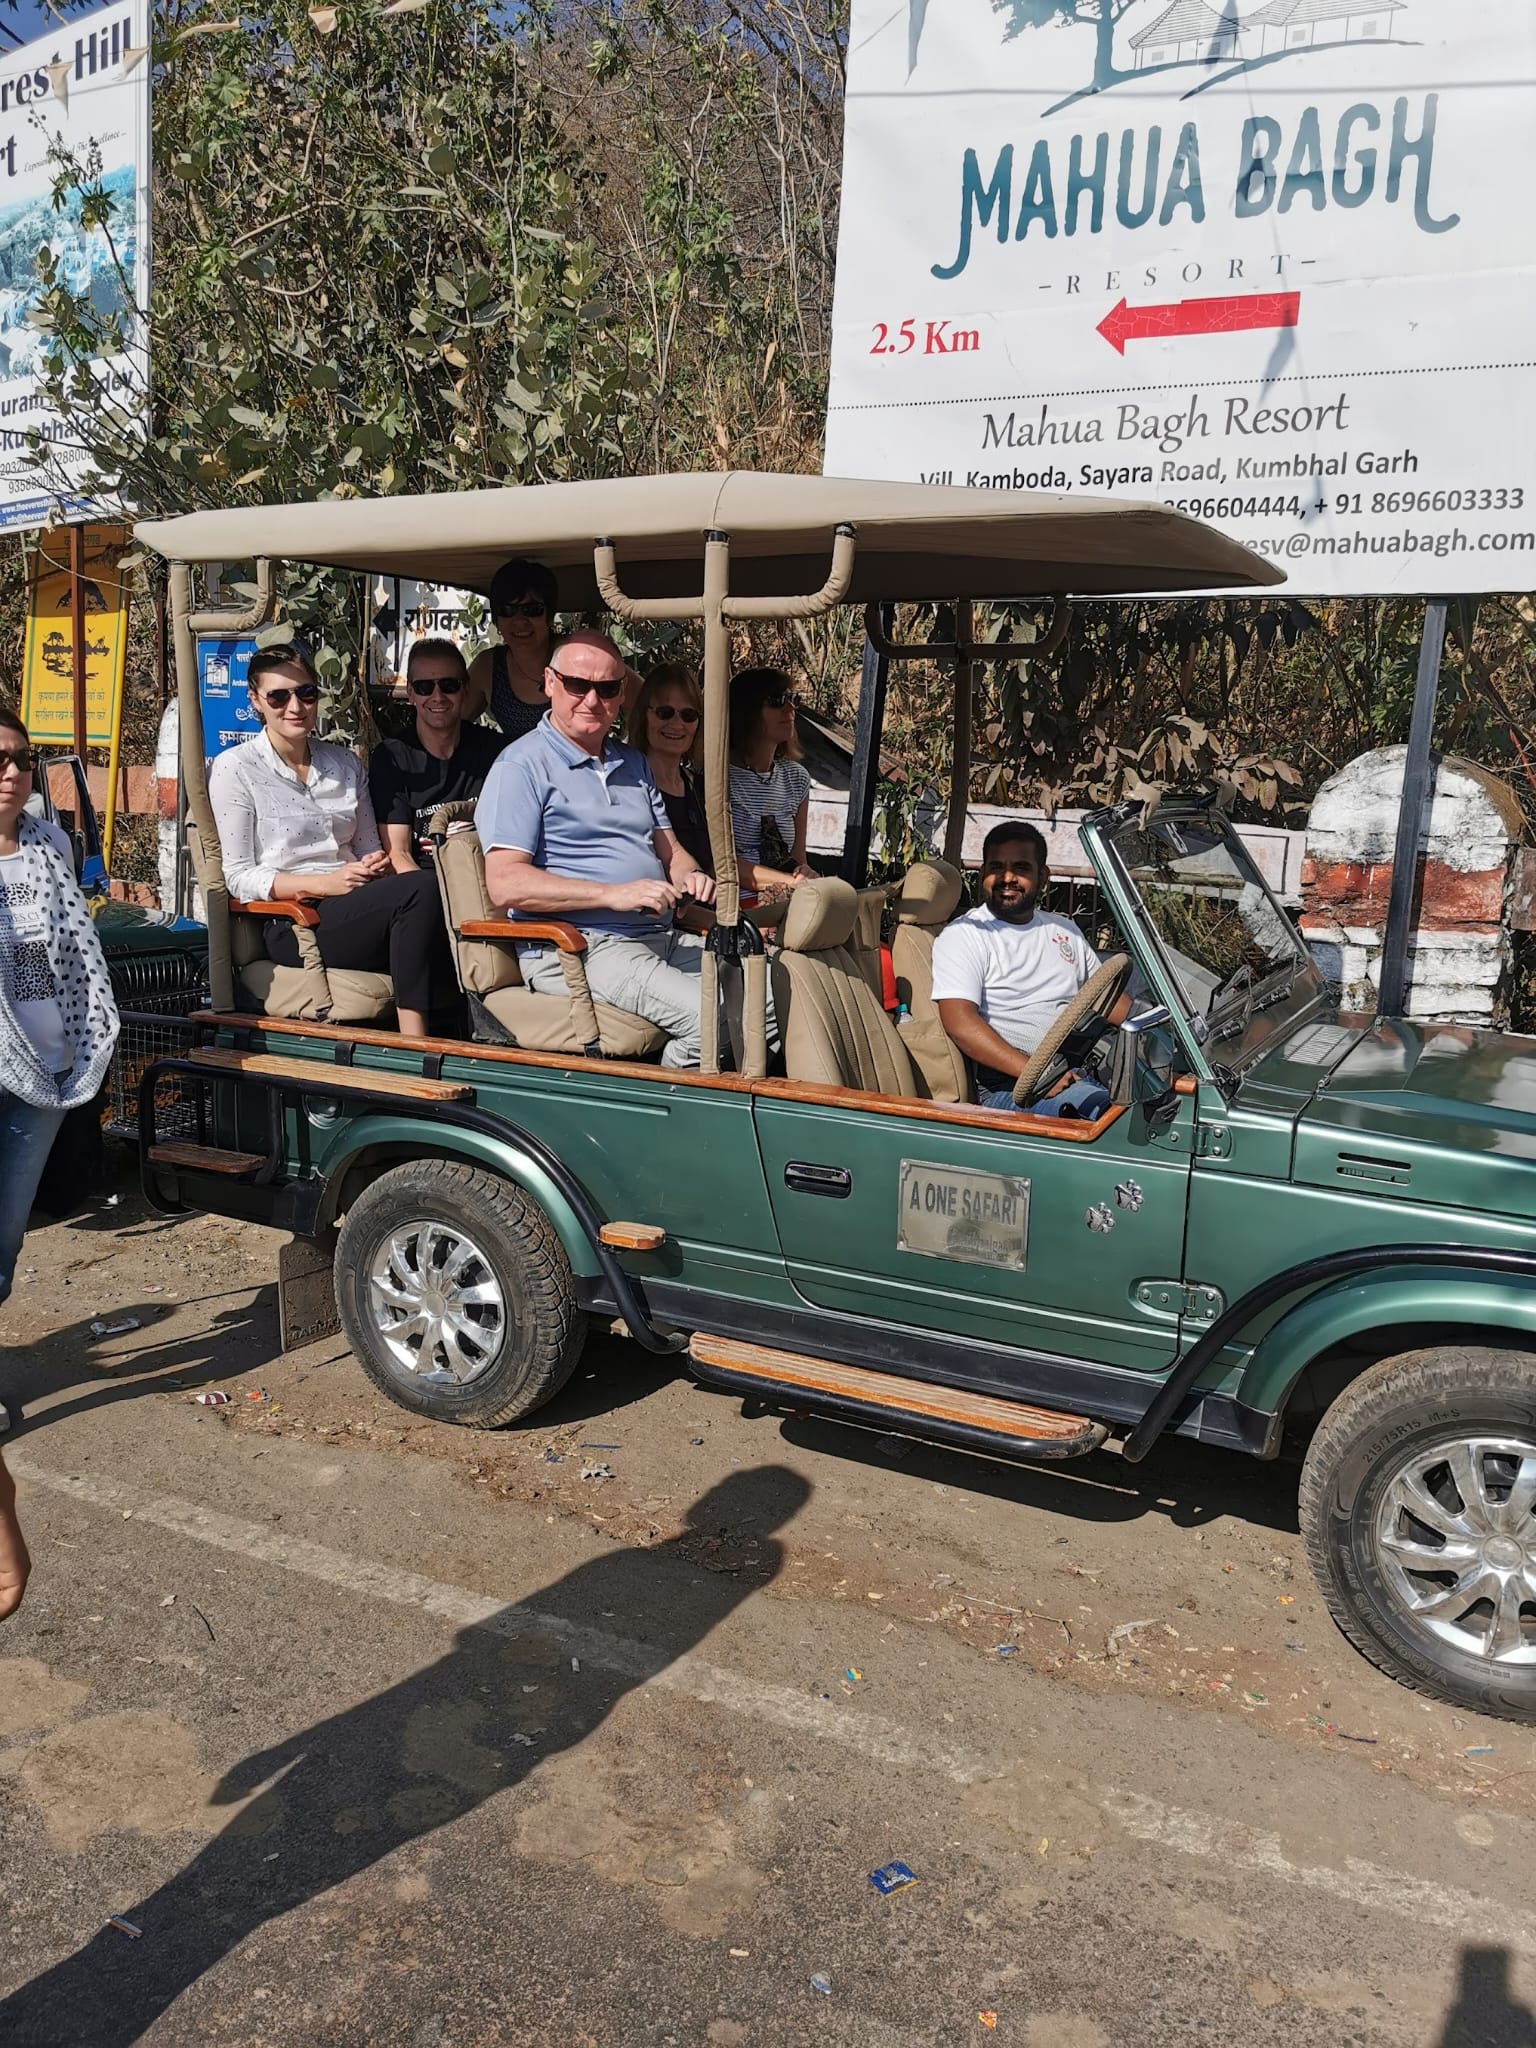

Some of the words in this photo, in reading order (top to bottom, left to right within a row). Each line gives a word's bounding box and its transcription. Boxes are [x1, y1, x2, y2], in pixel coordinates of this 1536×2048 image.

[75, 16, 131, 81] Hill
[930, 121, 1207, 280] MAHUA
[1235, 93, 1461, 234] BAGH
[869, 318, 915, 354] 2.5
[923, 320, 981, 354] Km
[981, 404, 1105, 449] Mahua
[1116, 394, 1211, 454] Bagh
[1223, 393, 1351, 436] Resort
[966, 466, 1073, 491] Kamboda,
[1080, 464, 1152, 489] Sayara
[1161, 457, 1227, 484] Road,
[1236, 451, 1347, 479] Kumbhal
[1356, 449, 1418, 475] Garh
[1314, 497, 1328, 514] +
[1335, 494, 1363, 515] 91
[1371, 487, 1525, 513] 8696603333
[910, 1180, 921, 1211] A
[925, 1182, 958, 1217] ONE
[962, 1188, 1017, 1226] SAFARI
[1363, 1417, 1422, 1463] 215/75R15
